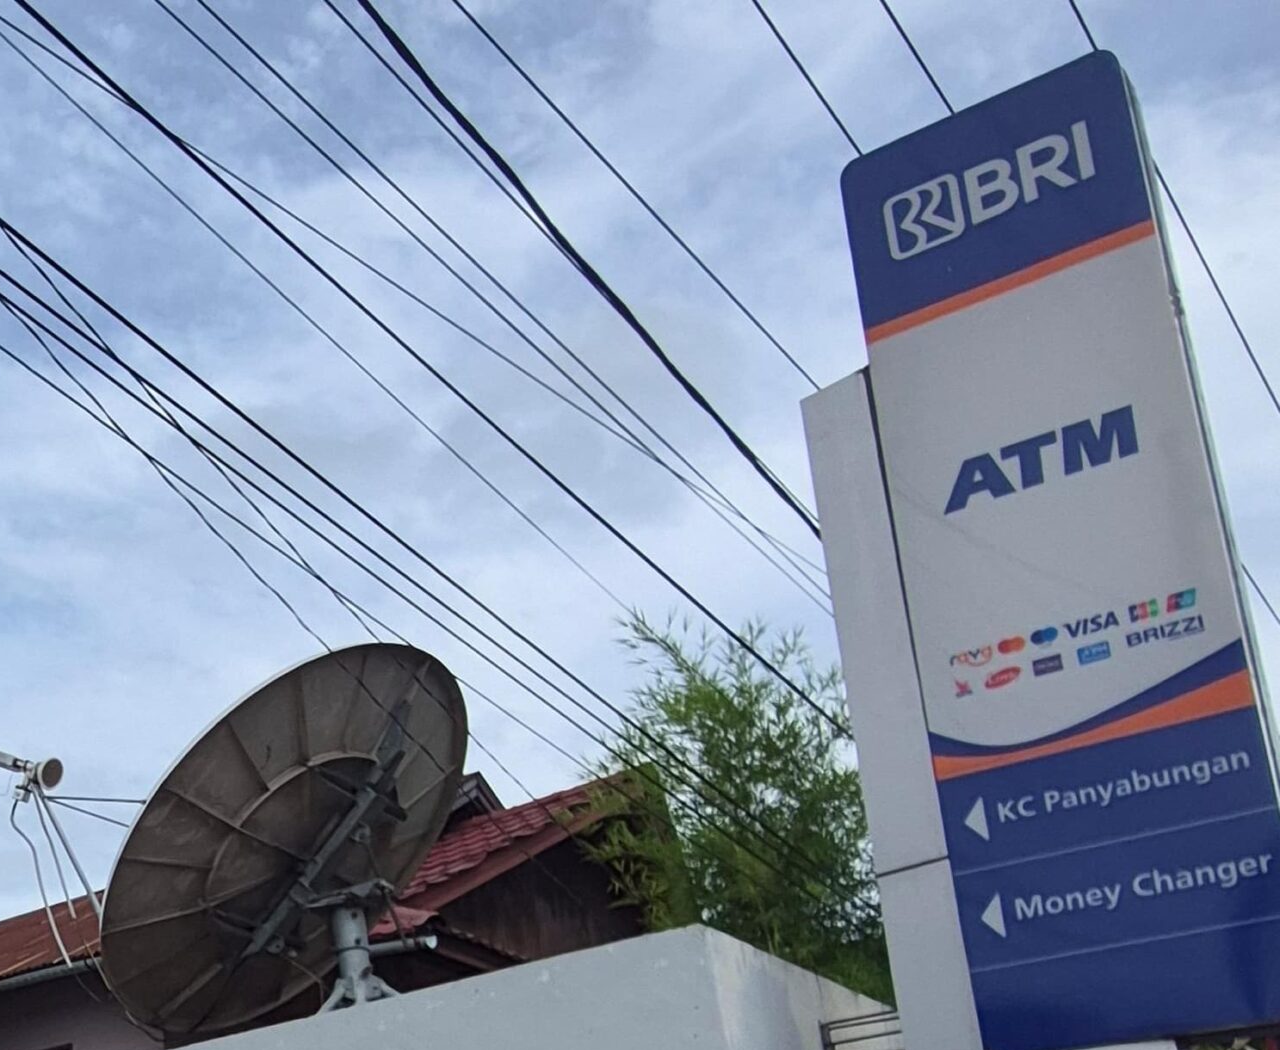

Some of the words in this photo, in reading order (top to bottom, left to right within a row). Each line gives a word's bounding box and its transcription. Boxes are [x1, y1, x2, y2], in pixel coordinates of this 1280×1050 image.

[963, 120, 1096, 225] BRI
[943, 404, 1139, 515] ATM
[1062, 610, 1120, 638] VISA
[1125, 614, 1205, 648] BRIZZI
[997, 796, 1037, 824] KC
[1043, 749, 1251, 813] Panyabungan
[1013, 881, 1121, 922] Money
[1131, 853, 1273, 899] Changer
